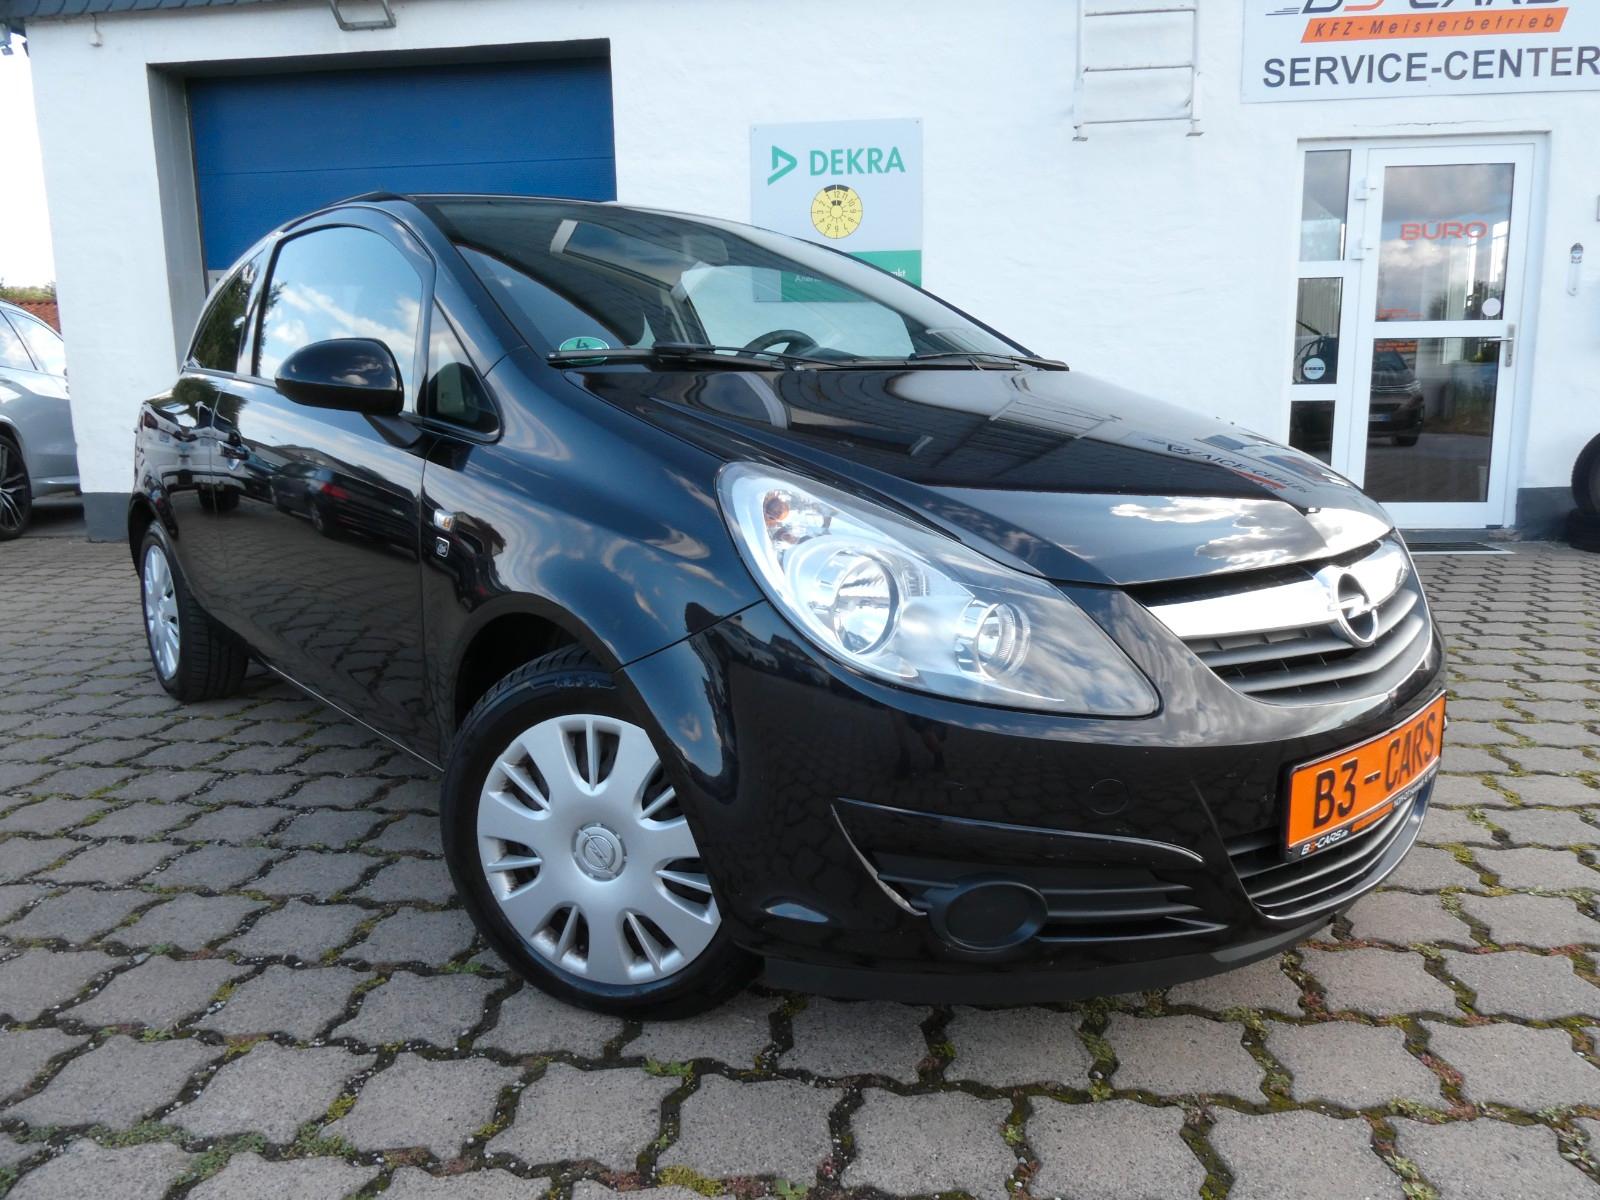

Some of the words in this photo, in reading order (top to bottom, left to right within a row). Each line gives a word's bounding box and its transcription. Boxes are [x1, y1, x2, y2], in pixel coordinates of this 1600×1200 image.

[1314, 14, 1556, 37] KFZ-Meisterbetrieb
[1262, 46, 1600, 87] SERVICE-CENTER
[809, 146, 906, 176] DEKRA
[1313, 711, 1436, 829] B3-CARS
